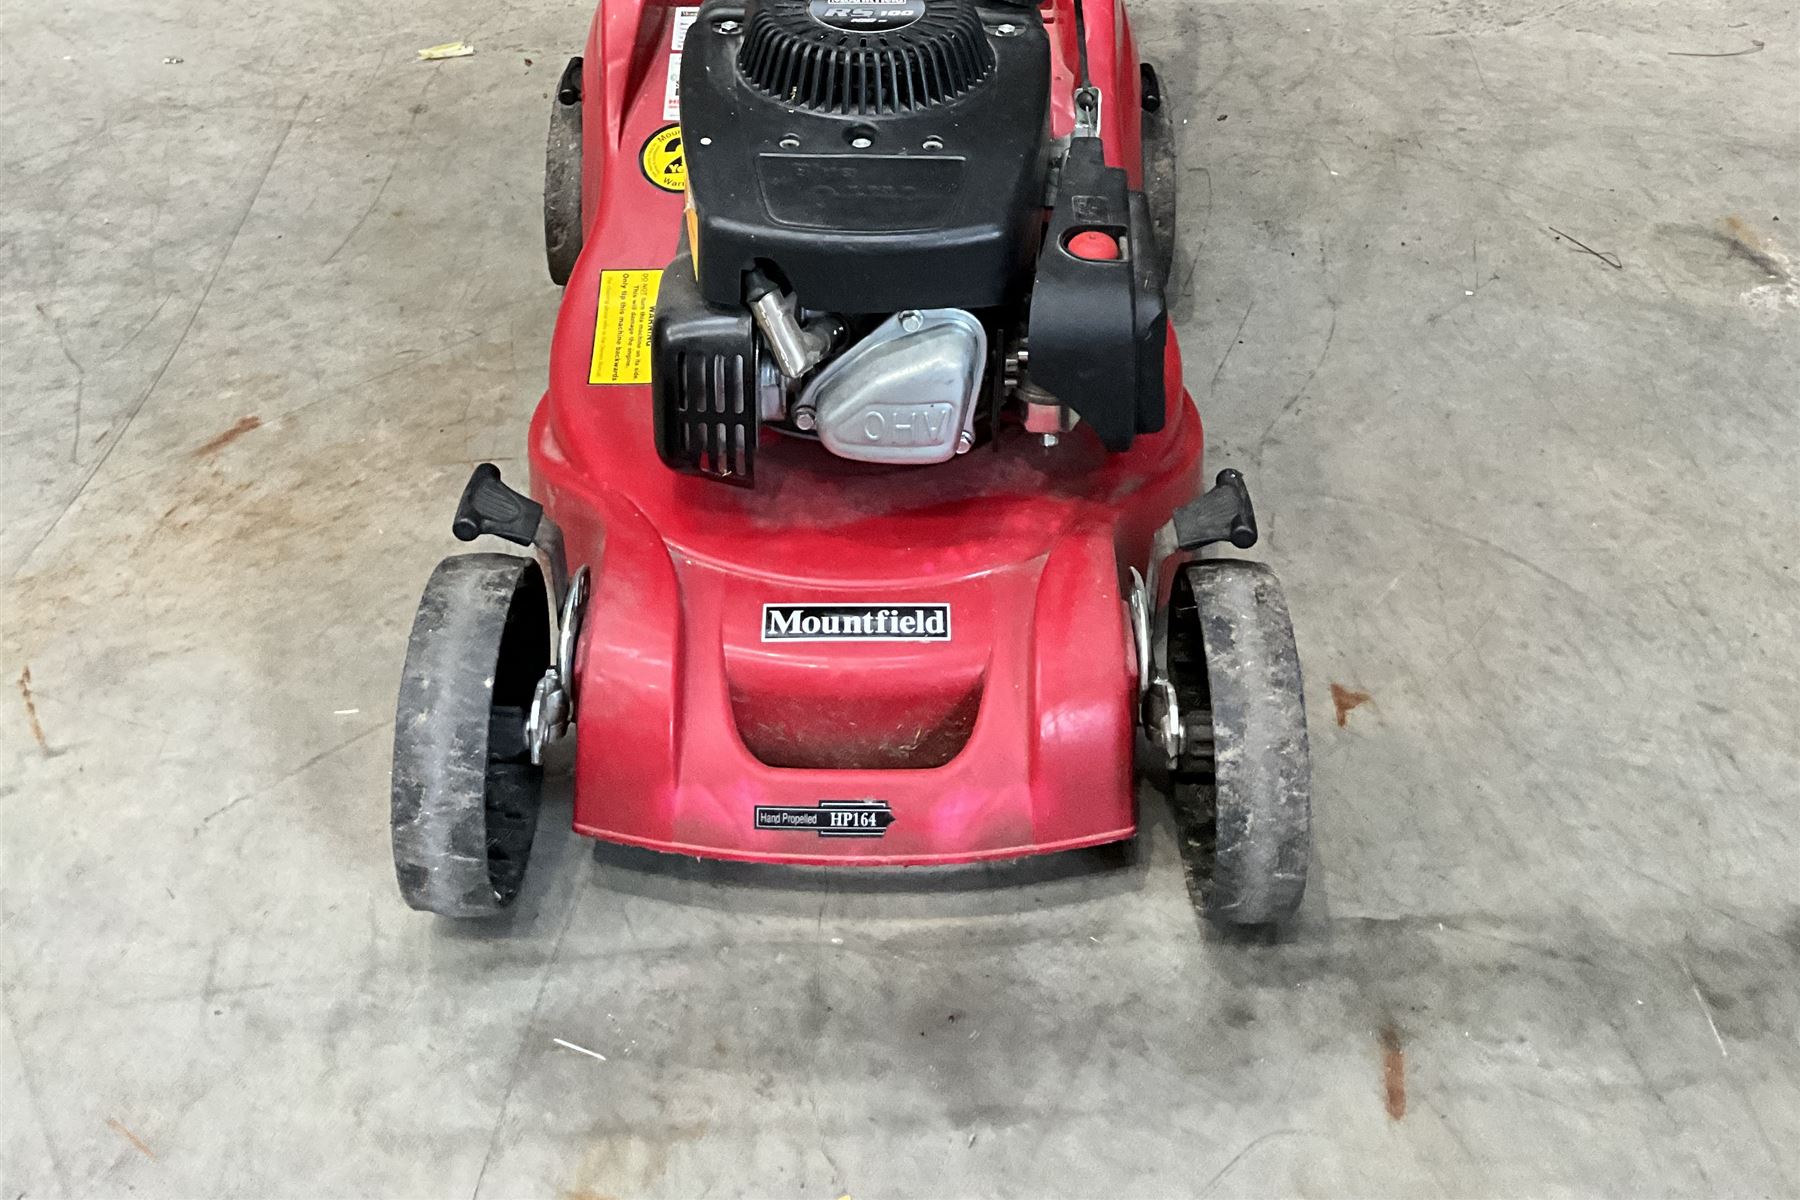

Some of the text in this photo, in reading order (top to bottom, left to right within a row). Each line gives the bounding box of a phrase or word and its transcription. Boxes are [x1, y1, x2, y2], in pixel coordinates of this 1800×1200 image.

[824, 8, 874, 17] RS
[620, 273, 630, 289] Only
[619, 302, 627, 315] this
[616, 316, 625, 346] machine
[628, 312, 637, 335] damage
[636, 324, 644, 349] machine
[864, 409, 950, 441] OHV
[767, 609, 946, 635] Mountfield
[760, 811, 877, 827] Hand Propelled HP164
